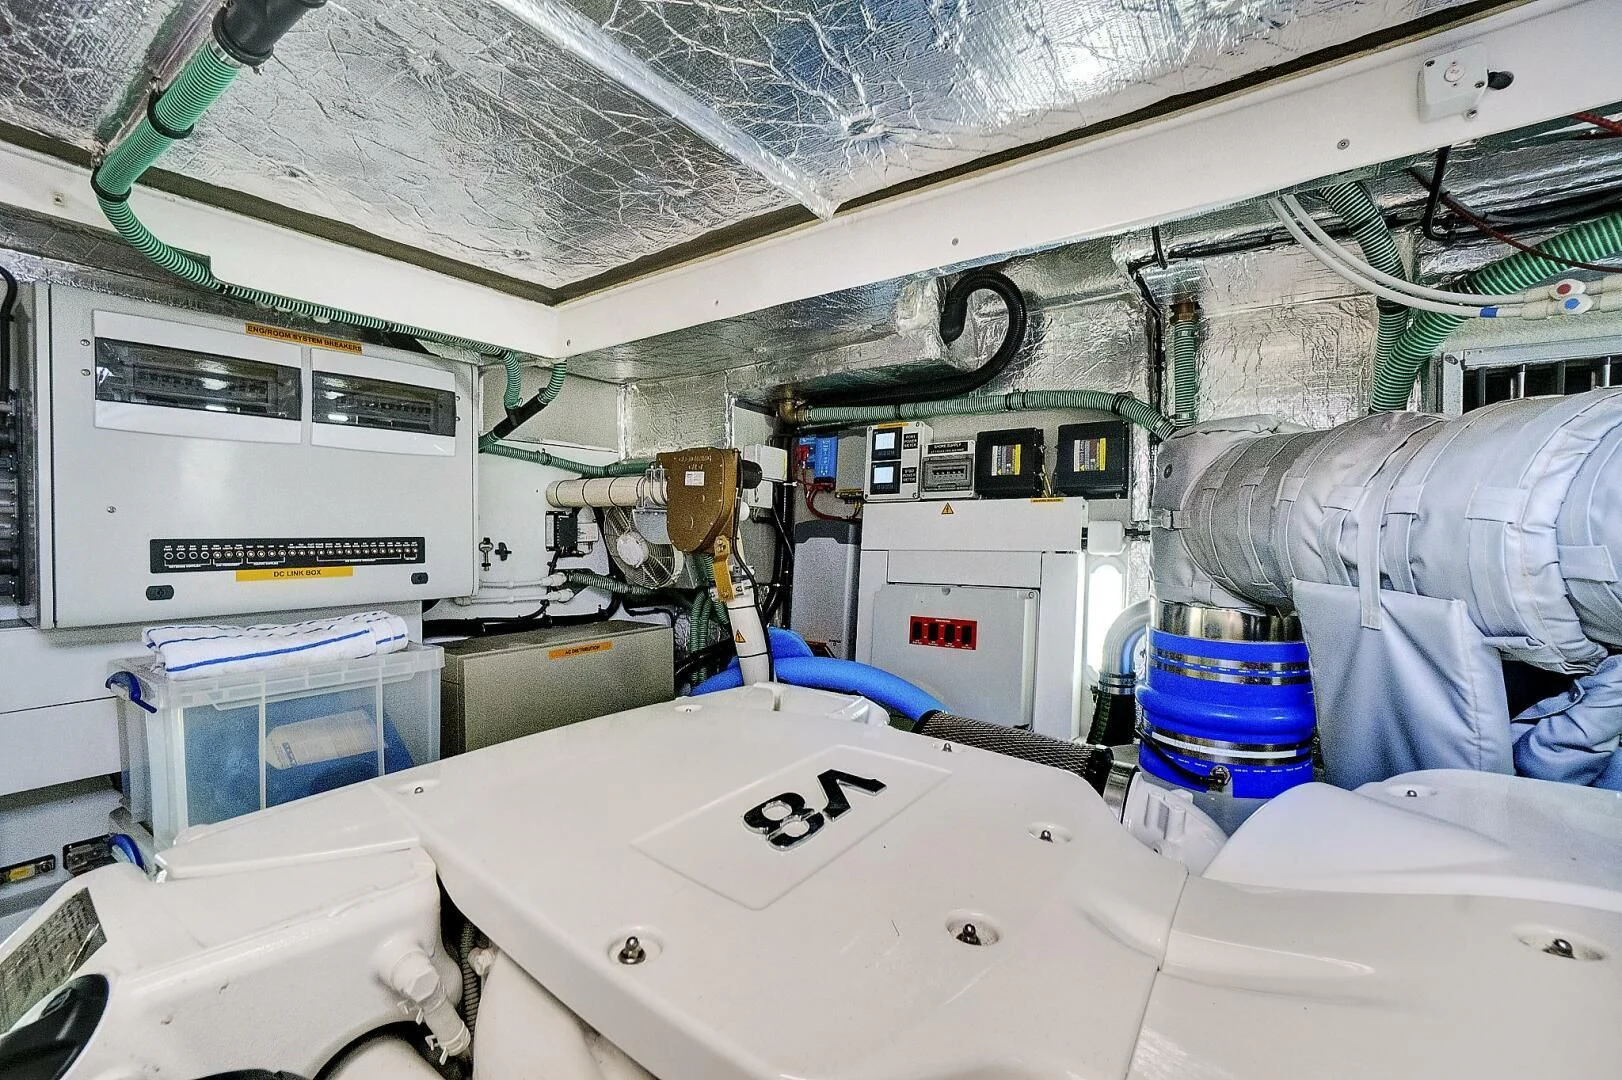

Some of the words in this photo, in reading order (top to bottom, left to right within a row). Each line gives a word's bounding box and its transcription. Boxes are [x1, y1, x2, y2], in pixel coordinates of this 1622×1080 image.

[247, 325, 291, 338] ENG/ROOM
[292, 334, 323, 345] SYSTEM
[324, 339, 362, 352] BREAKERS
[743, 768, 887, 852] V8
